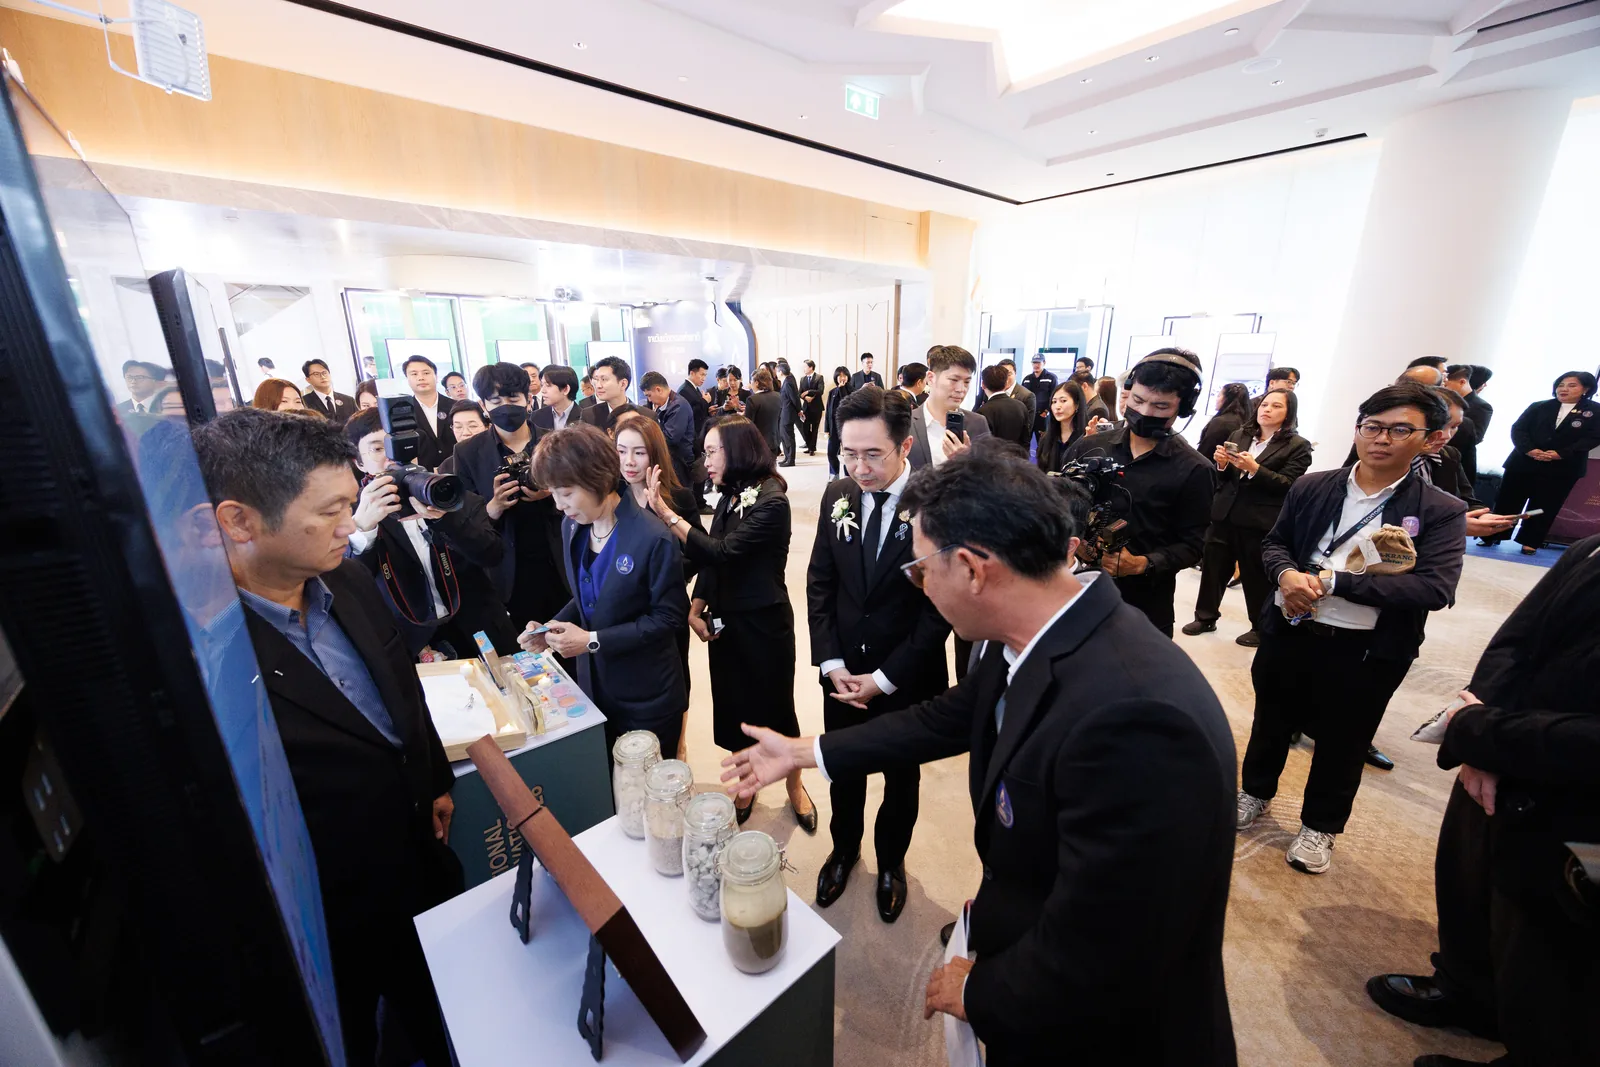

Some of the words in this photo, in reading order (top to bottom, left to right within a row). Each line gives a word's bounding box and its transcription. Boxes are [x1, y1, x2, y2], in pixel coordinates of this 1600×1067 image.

[382, 562, 392, 580] EOS
[439, 552, 451, 576] Canon
[484, 818, 509, 878] IONAL
